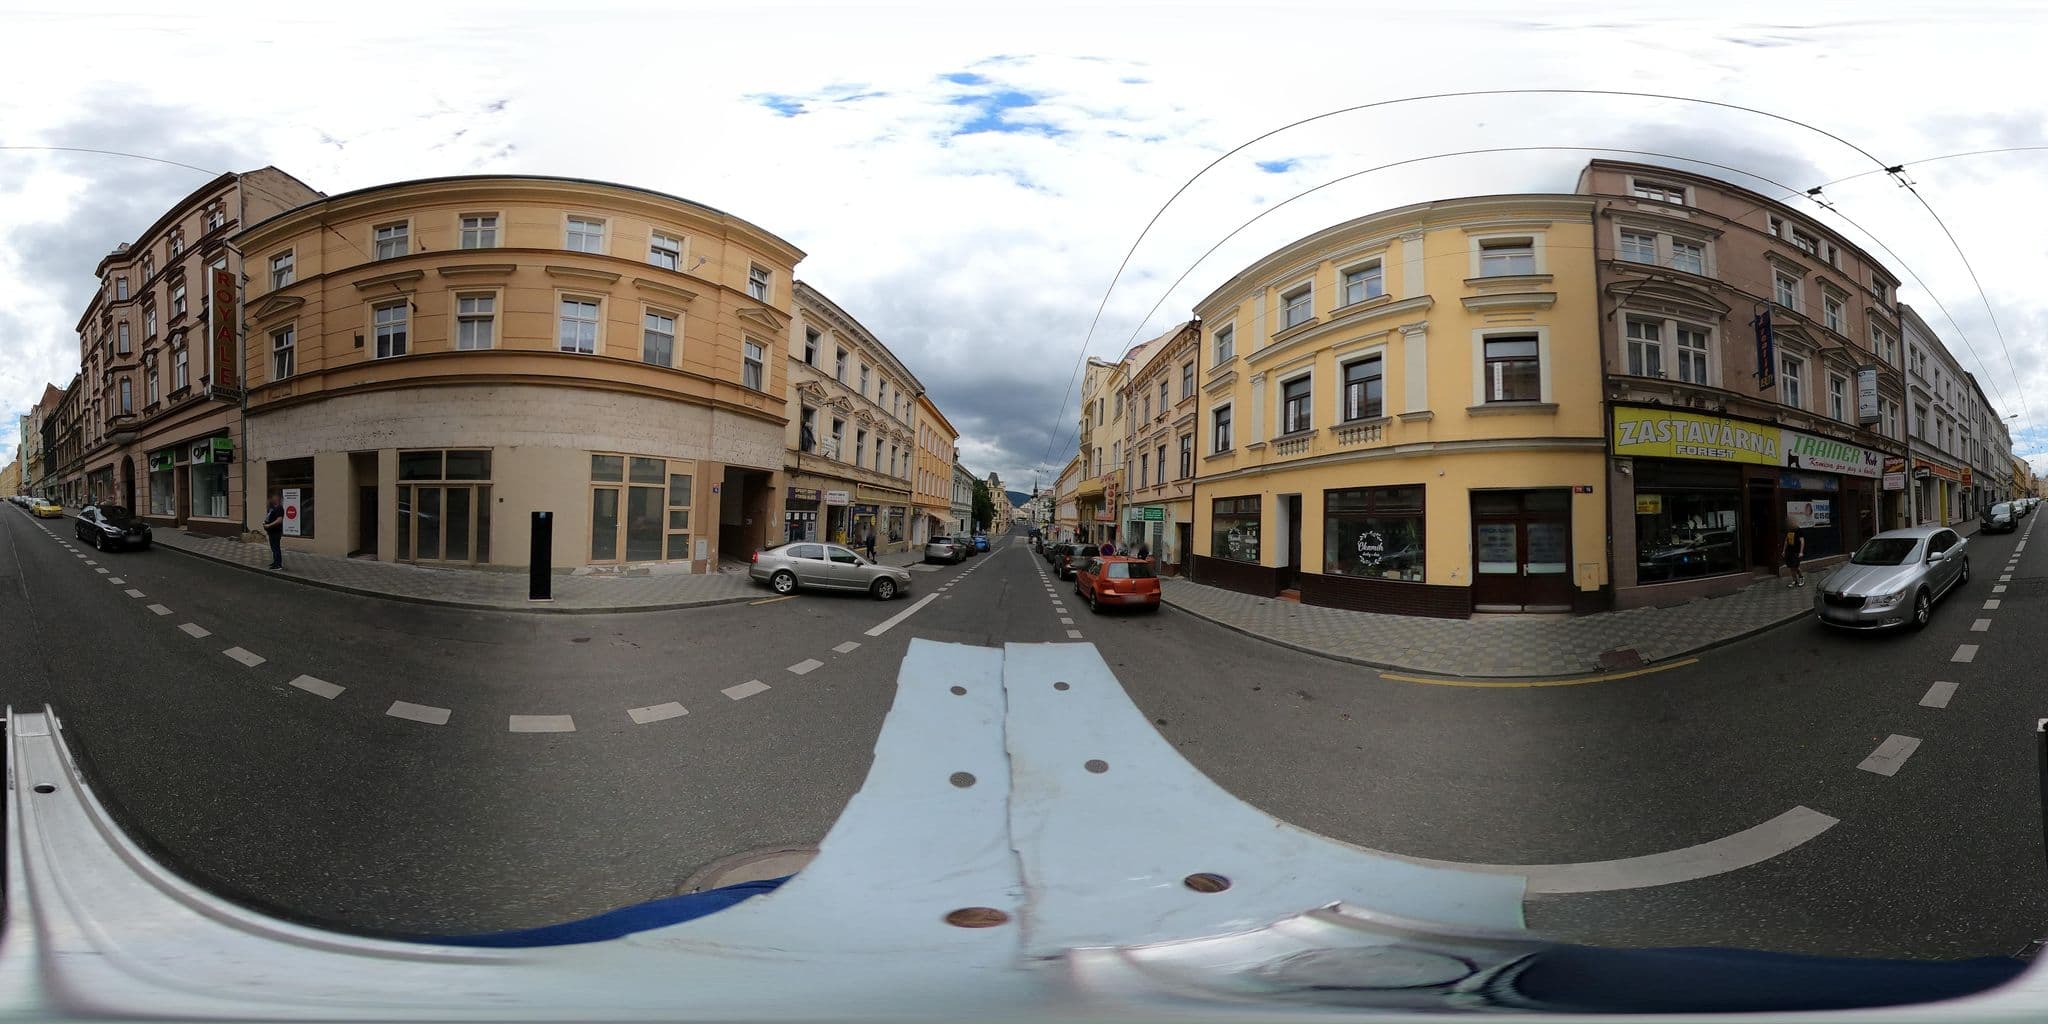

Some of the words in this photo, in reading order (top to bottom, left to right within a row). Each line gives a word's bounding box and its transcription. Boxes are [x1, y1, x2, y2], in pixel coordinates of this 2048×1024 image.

[216, 271, 234, 385] ROYALE
[1618, 419, 1778, 459] ZASTAVÁRNA
[1675, 445, 1736, 459] FOREST
[1793, 434, 1861, 464] TRAINER
